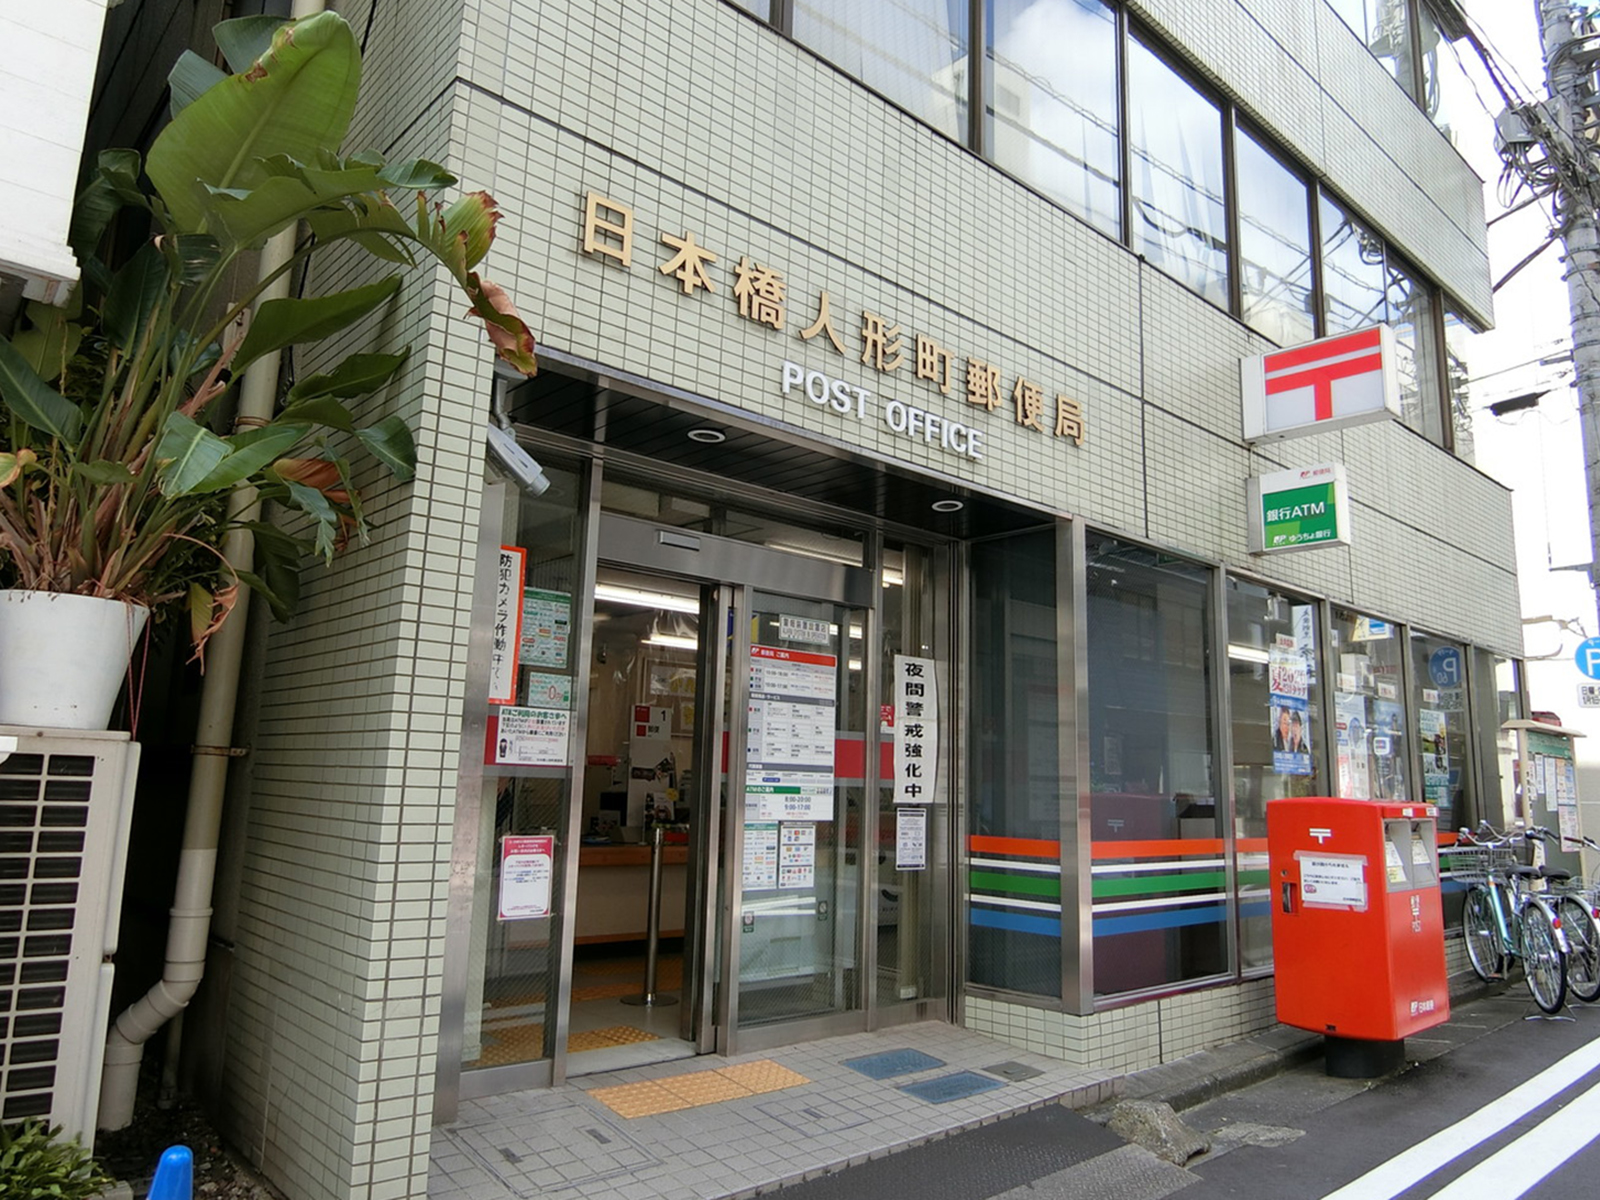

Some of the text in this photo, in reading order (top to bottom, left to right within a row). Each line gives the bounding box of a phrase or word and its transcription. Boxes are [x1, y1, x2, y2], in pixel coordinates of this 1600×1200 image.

[583, 191, 1085, 447] 日本橋人形町郵便局
[781, 361, 984, 460] POST OFFICE
[1266, 501, 1325, 522] 銀行ATM
[1289, 529, 1331, 543] ゆうちょ銀行
[905, 663, 924, 798] 夜間警戒強化中
